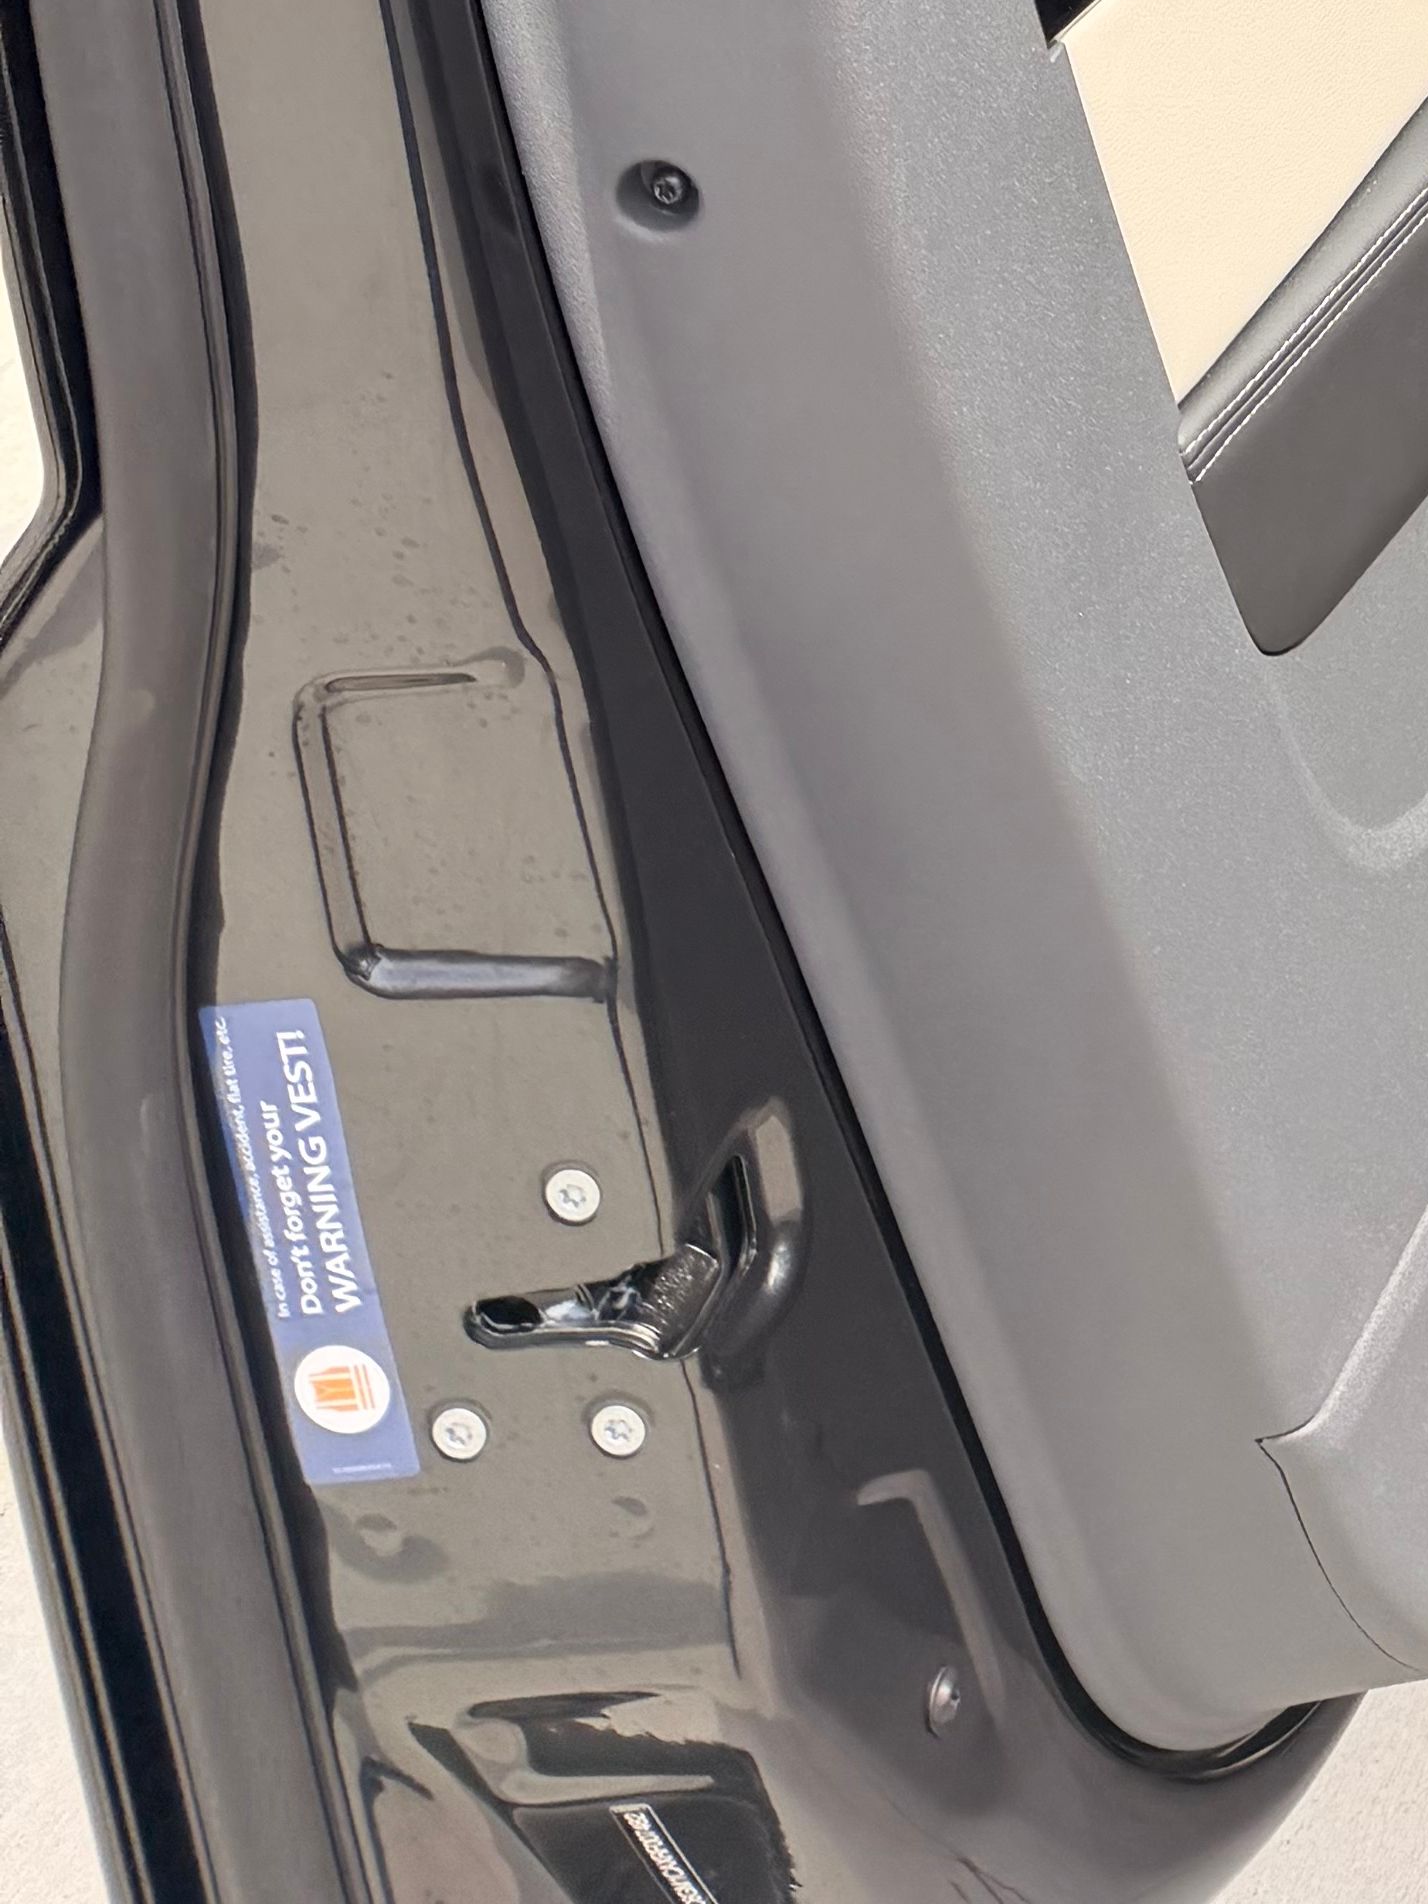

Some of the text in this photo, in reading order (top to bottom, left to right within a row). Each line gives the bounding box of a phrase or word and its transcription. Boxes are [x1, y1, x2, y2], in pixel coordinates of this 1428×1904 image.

[221, 1045, 237, 1077] tire,
[225, 1078, 242, 1104] flat
[231, 1104, 256, 1172] accident,
[260, 1100, 293, 1162] your
[275, 1030, 363, 1313] WARNING VEST!
[247, 1173, 276, 1248] assistance,
[271, 1164, 308, 1242] forget
[262, 1249, 279, 1266] of
[270, 1267, 287, 1301] case
[277, 1302, 291, 1318] In
